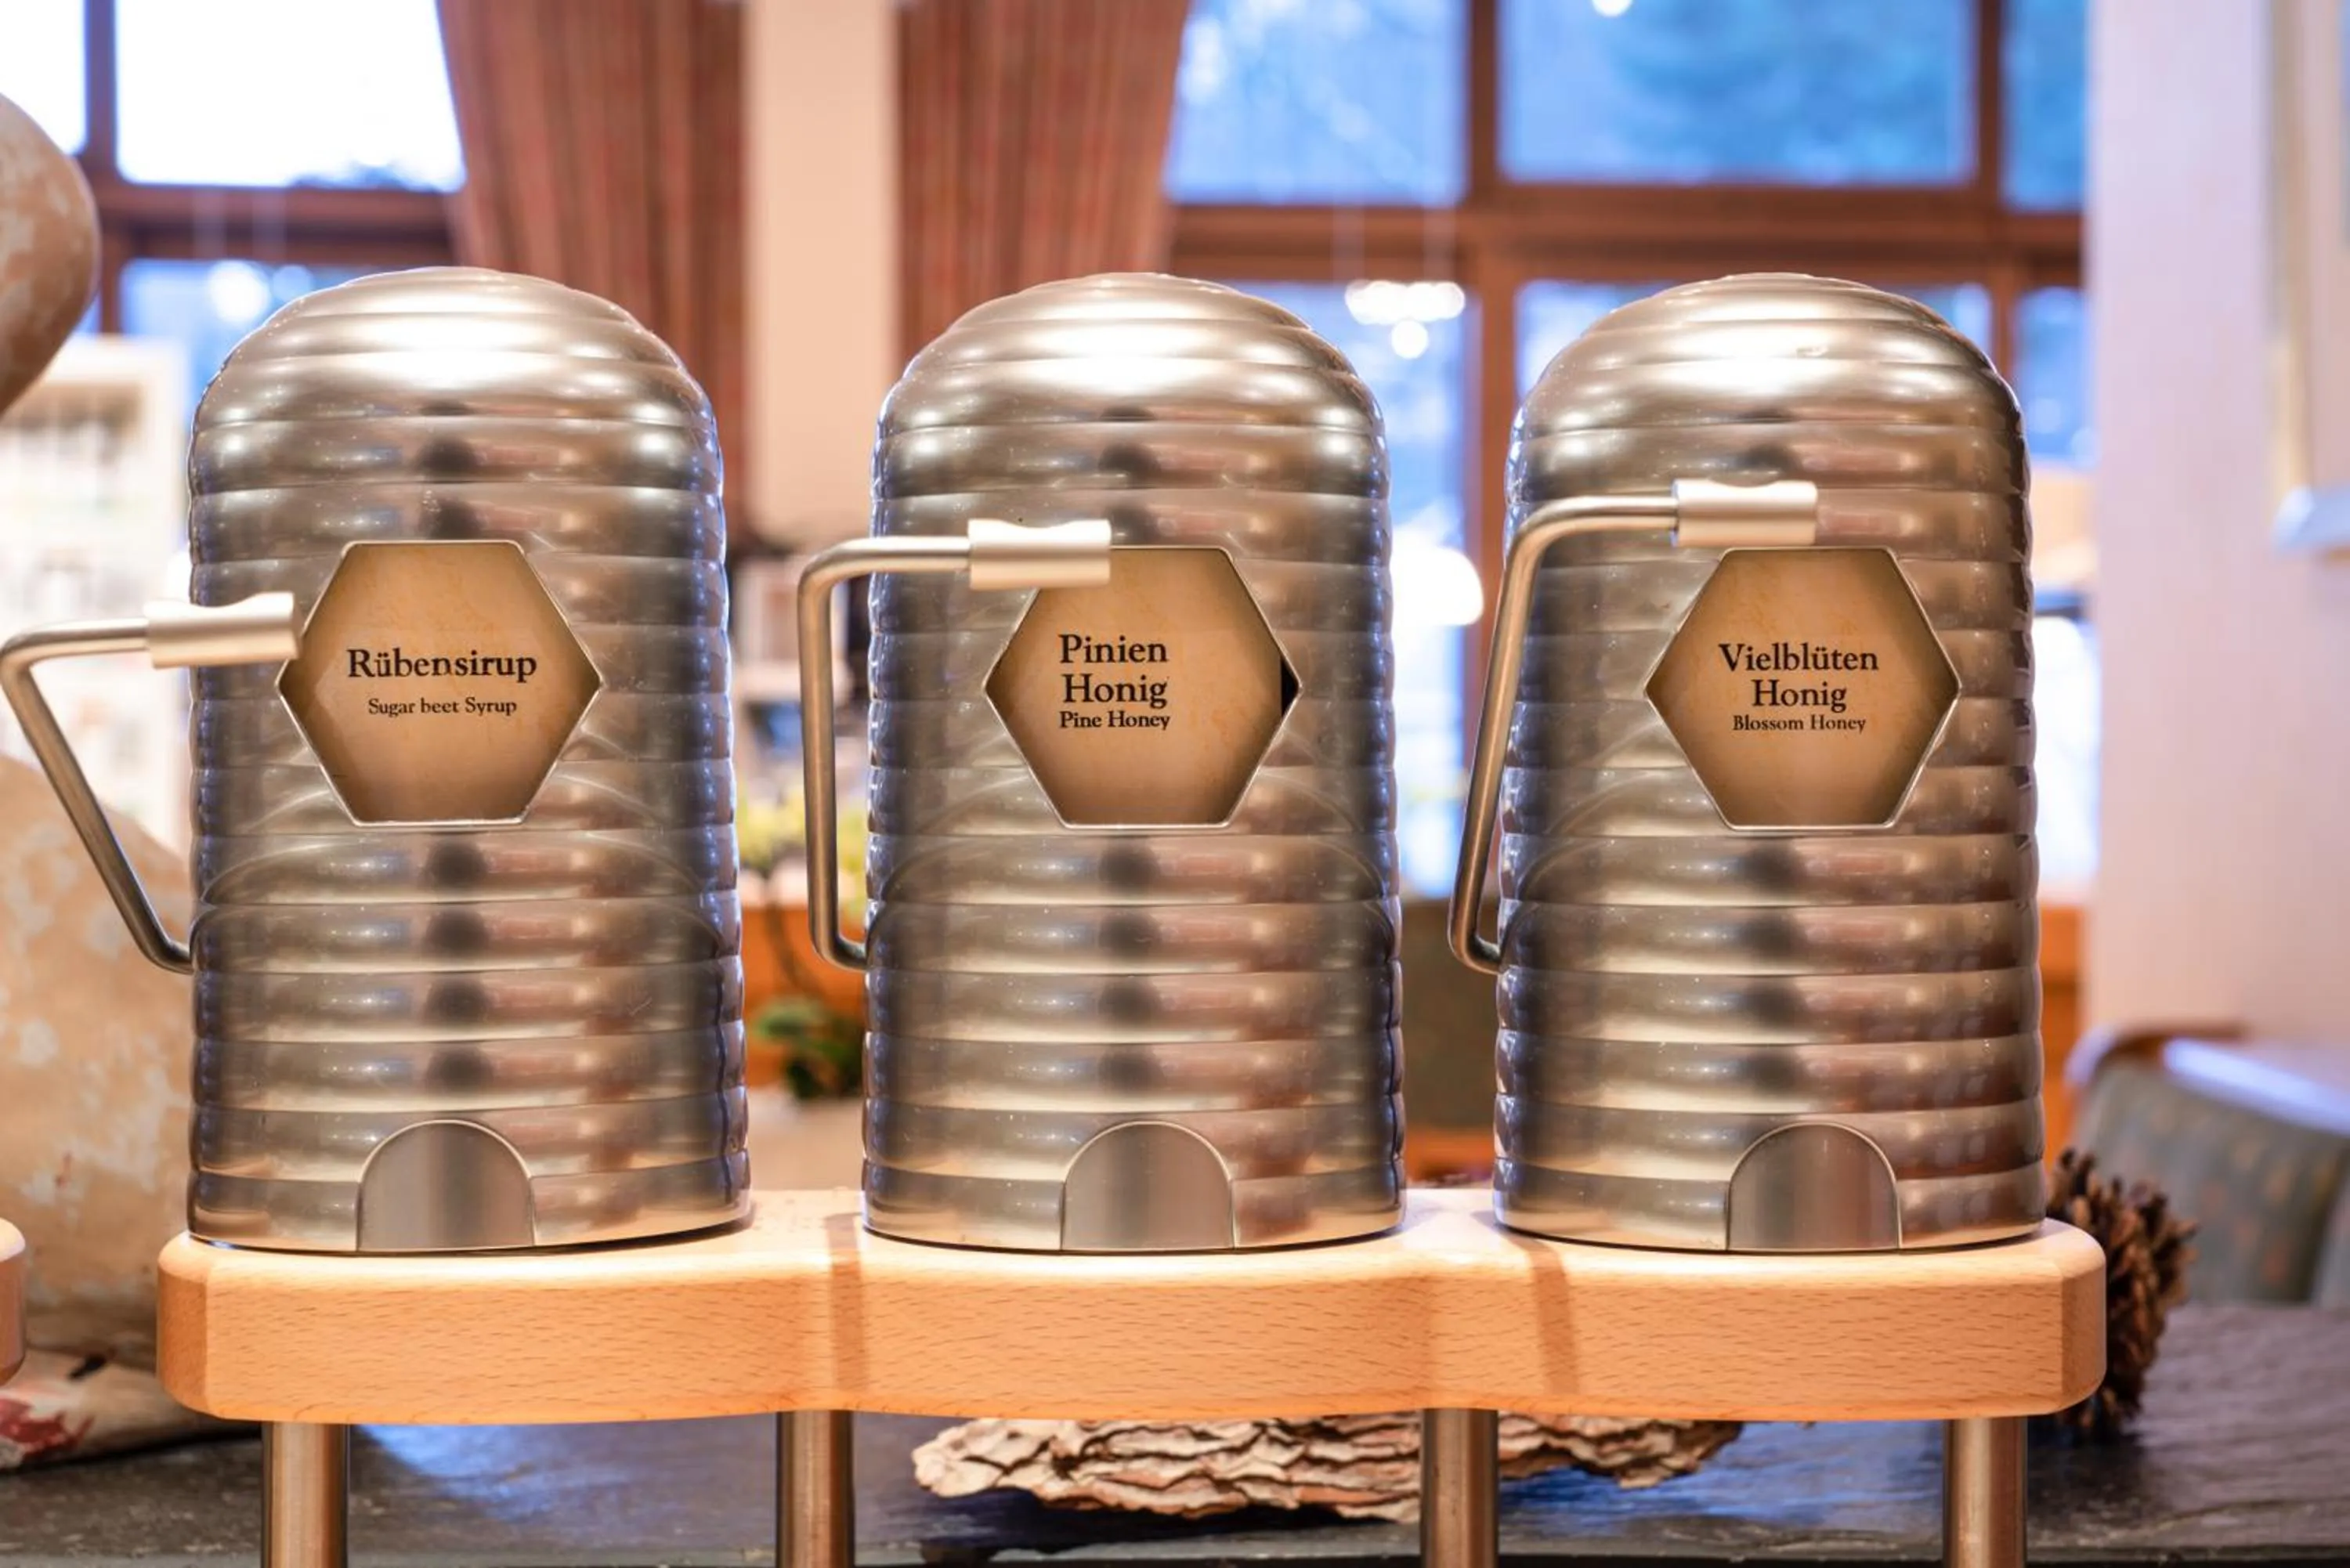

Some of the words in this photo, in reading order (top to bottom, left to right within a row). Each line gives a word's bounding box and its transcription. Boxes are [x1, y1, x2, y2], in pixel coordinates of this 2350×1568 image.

[1058, 634, 1170, 664] Pinien
[1717, 641, 1879, 672] Vielblüten
[346, 647, 537, 684] Rübensirup
[1061, 673, 1170, 710] Honig
[1752, 678, 1847, 714] Honig
[368, 696, 416, 718] Sugar
[420, 696, 460, 717] beet
[465, 696, 518, 719] Syrup
[1059, 710, 1103, 729] Pine
[1107, 710, 1172, 732] Honey
[1733, 714, 1804, 732] Blossom
[1810, 714, 1867, 733] Honey
